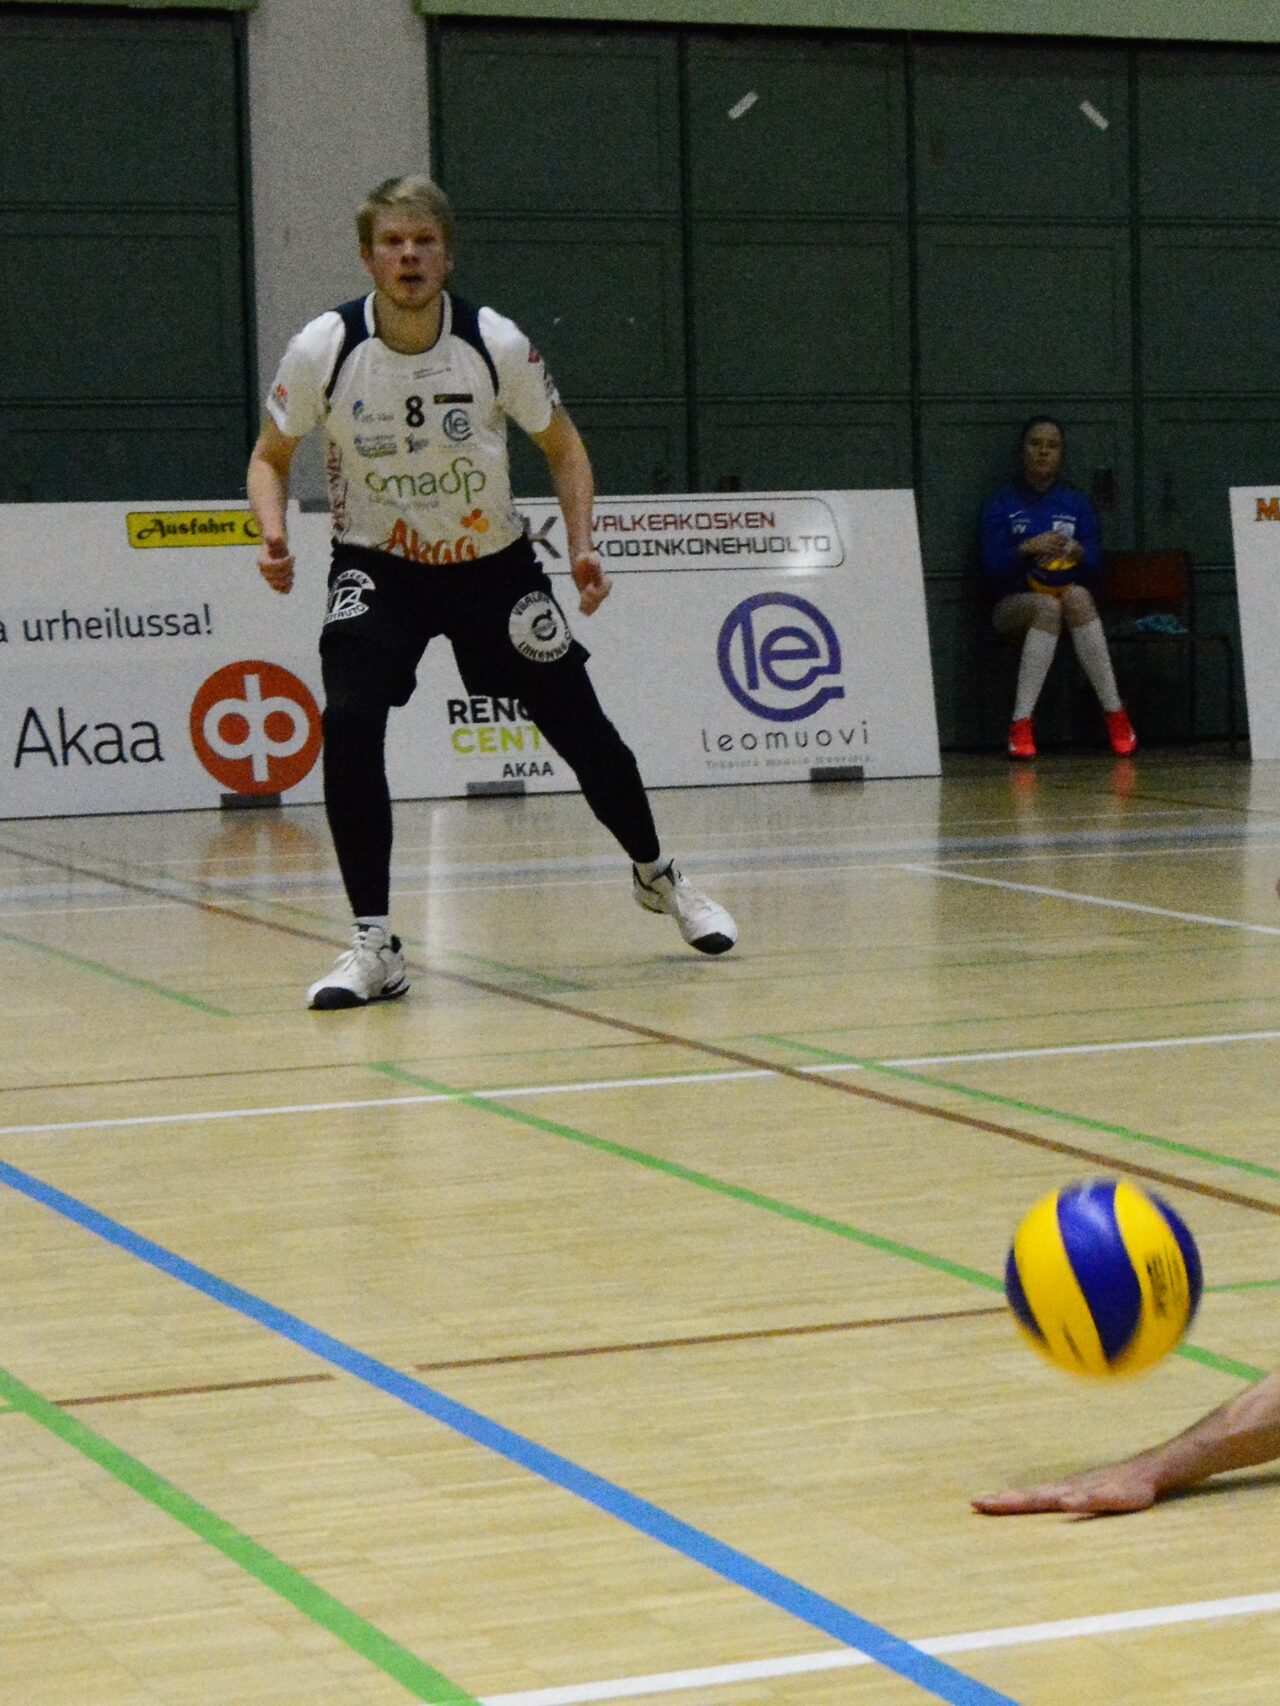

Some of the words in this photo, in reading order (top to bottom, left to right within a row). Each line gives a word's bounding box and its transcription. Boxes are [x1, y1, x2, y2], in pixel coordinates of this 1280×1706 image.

[405, 395, 425, 428] 8
[591, 511, 775, 532] VALKEAKOSKEN
[22, 603, 213, 643] urheilussa!
[14, 706, 165, 768] Akaa
[701, 720, 869, 753] leomuovi
[503, 761, 555, 777] AKAA
